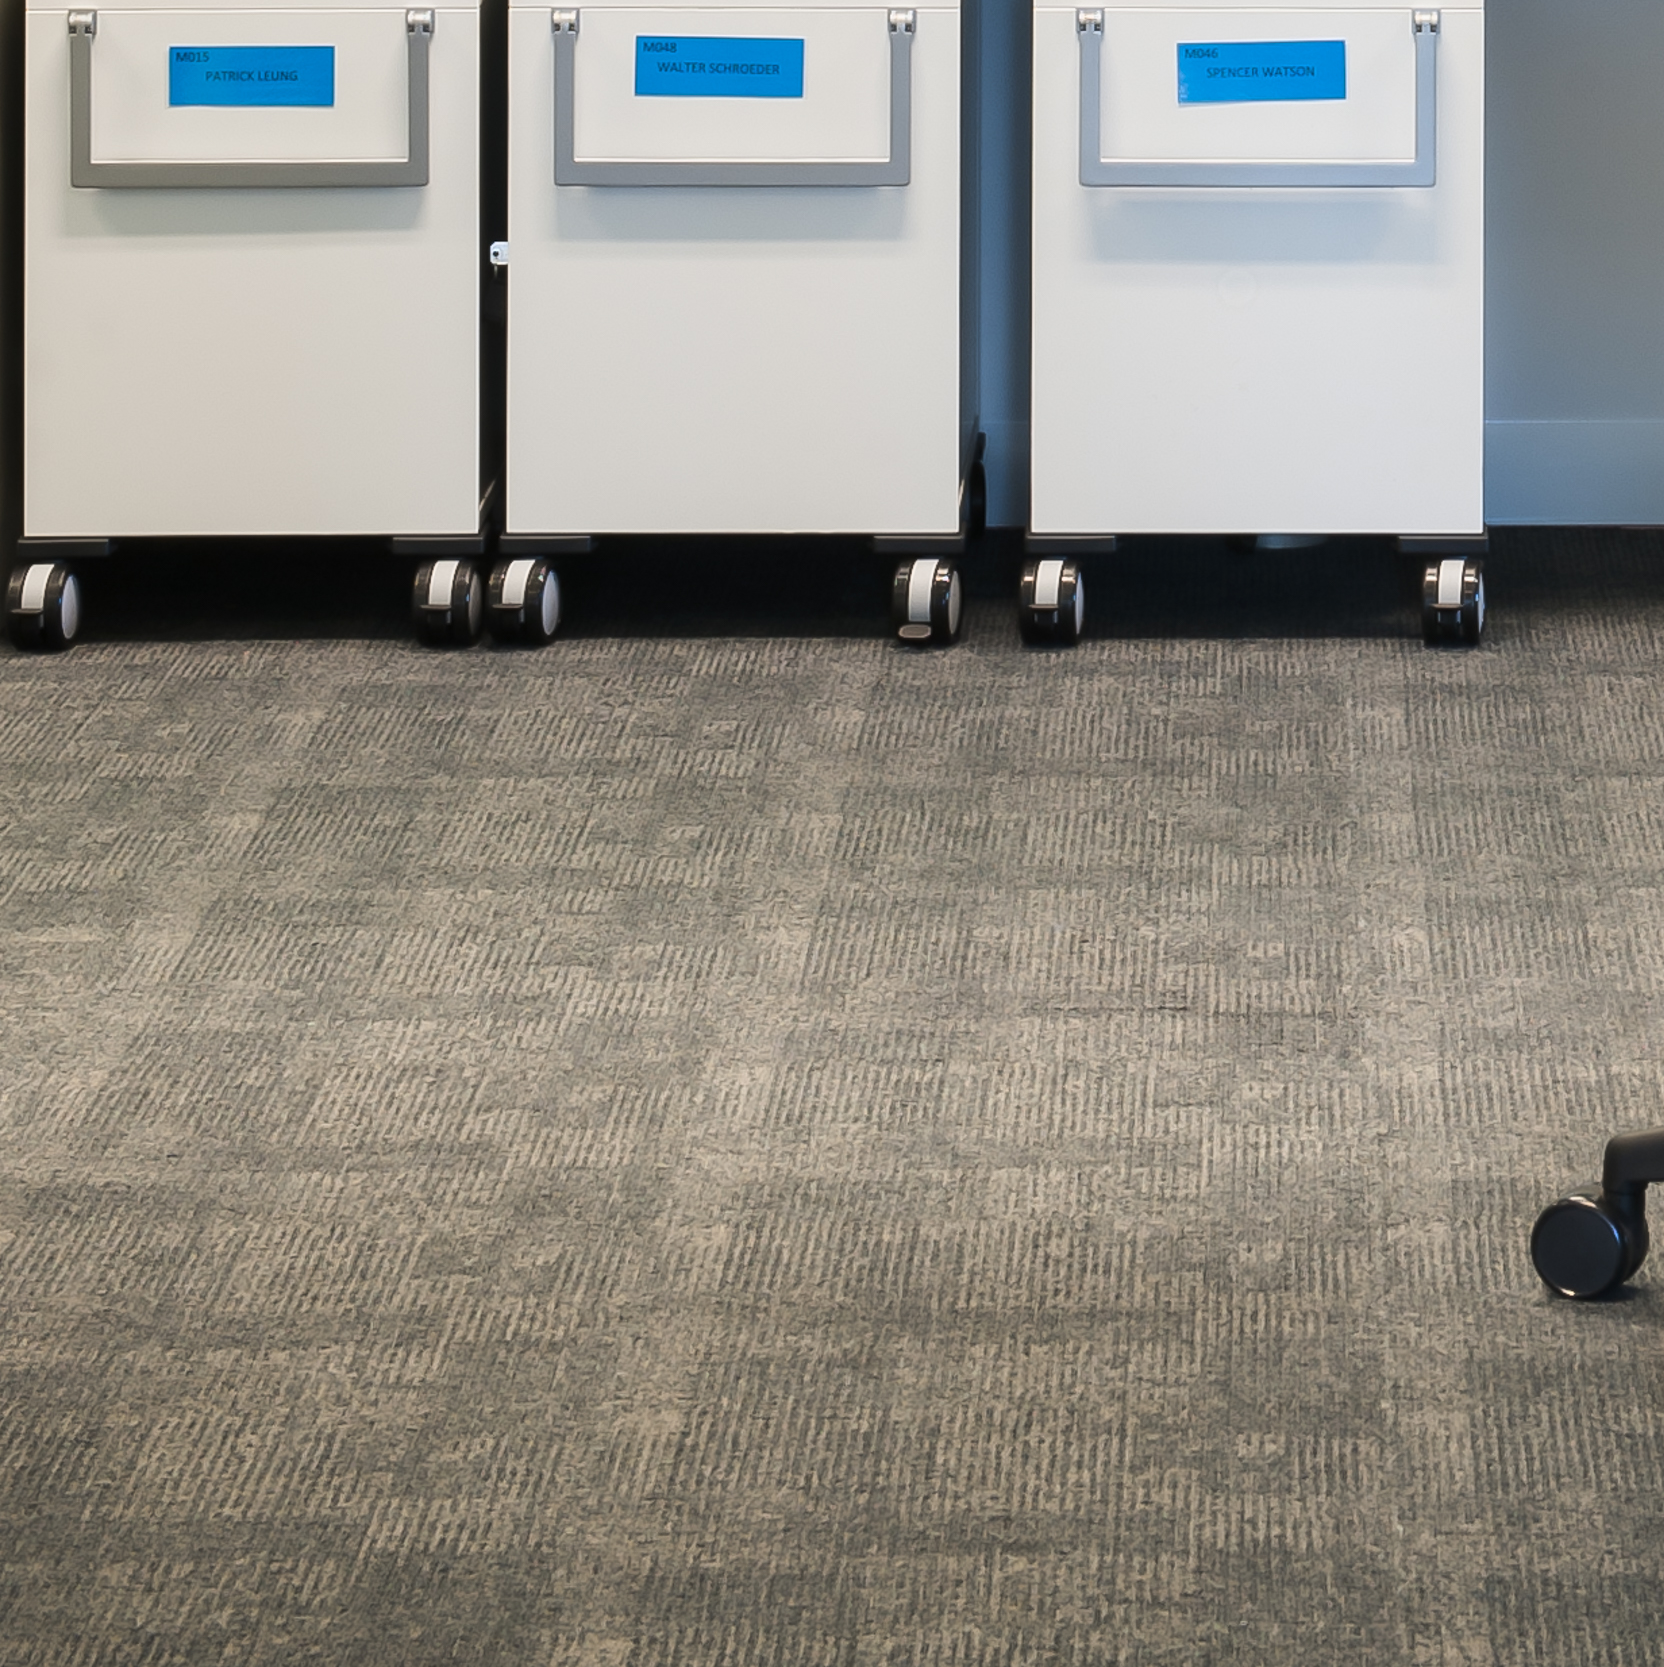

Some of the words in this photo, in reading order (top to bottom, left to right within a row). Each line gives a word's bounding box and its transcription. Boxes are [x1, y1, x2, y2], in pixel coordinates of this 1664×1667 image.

[175, 51, 210, 63] M015
[1184, 48, 1219, 59] M046
[657, 62, 706, 73] WALTER
[708, 63, 780, 75] SCHROEDER
[1206, 67, 1259, 78] SPENCER
[1262, 66, 1315, 77] WATSON
[205, 71, 254, 82] PATRICK
[257, 70, 298, 82] LEUNG
